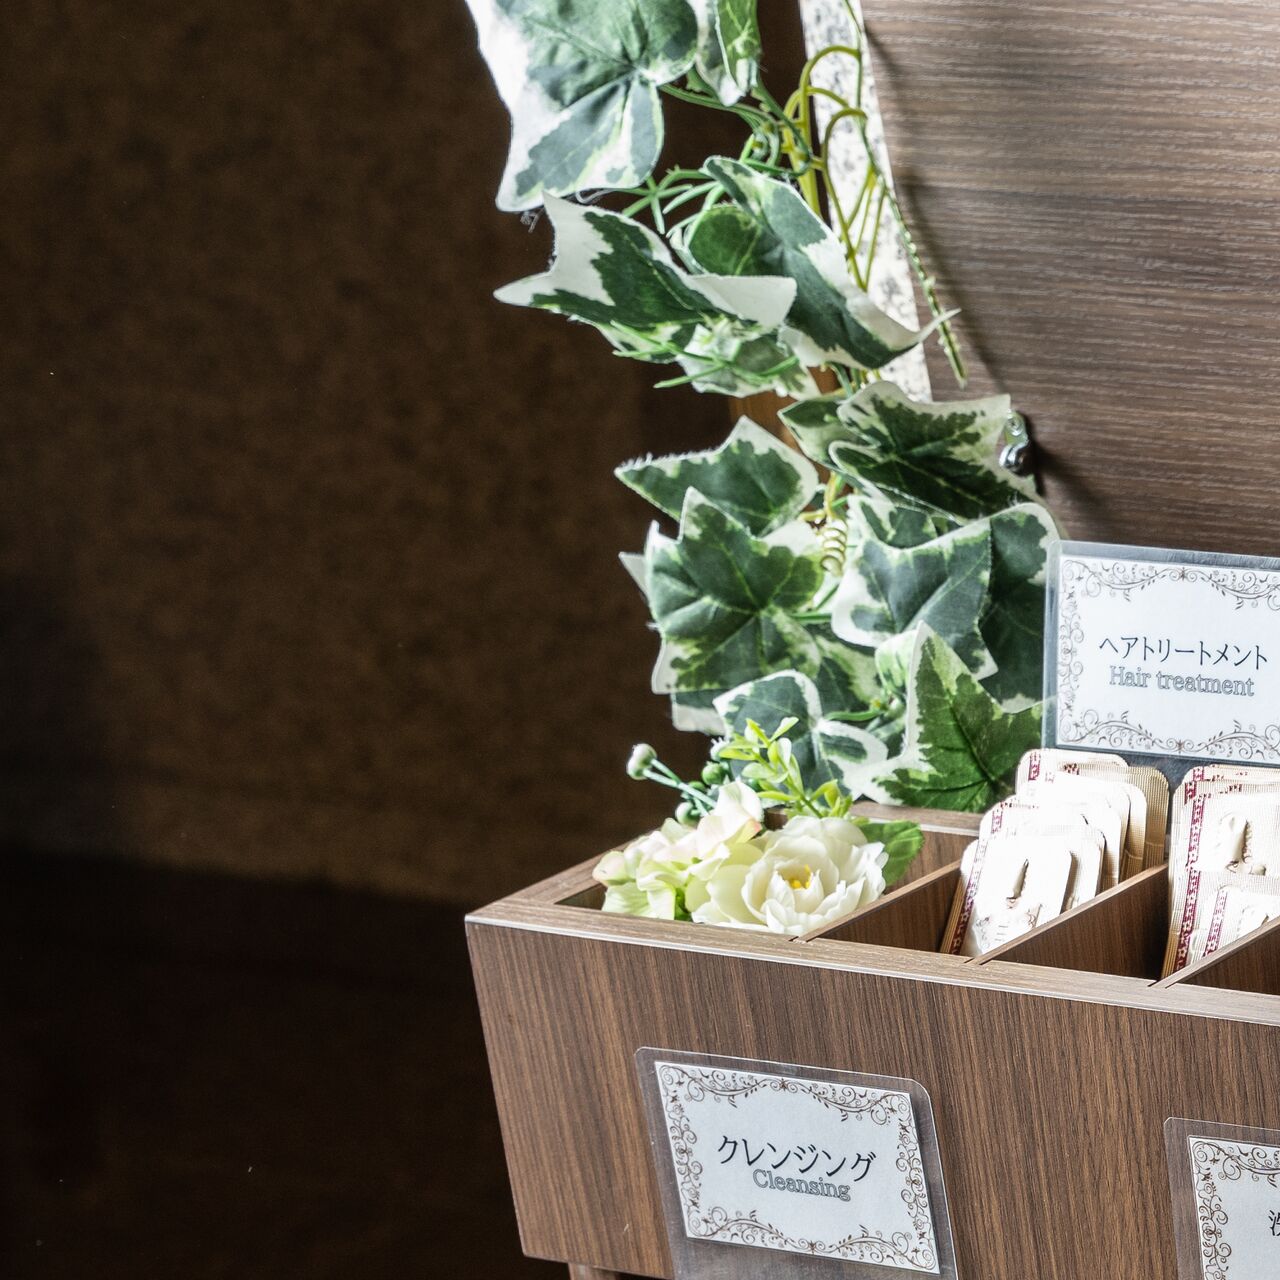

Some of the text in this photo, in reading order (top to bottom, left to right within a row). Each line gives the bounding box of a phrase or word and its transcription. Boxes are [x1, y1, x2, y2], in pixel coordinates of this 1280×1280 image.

[1099, 636, 1268, 671] ヘアトリートメント
[1109, 665, 1255, 697] Hair treatment
[717, 1135, 876, 1182] クレンジング
[752, 1168, 851, 1202] Cleansing
